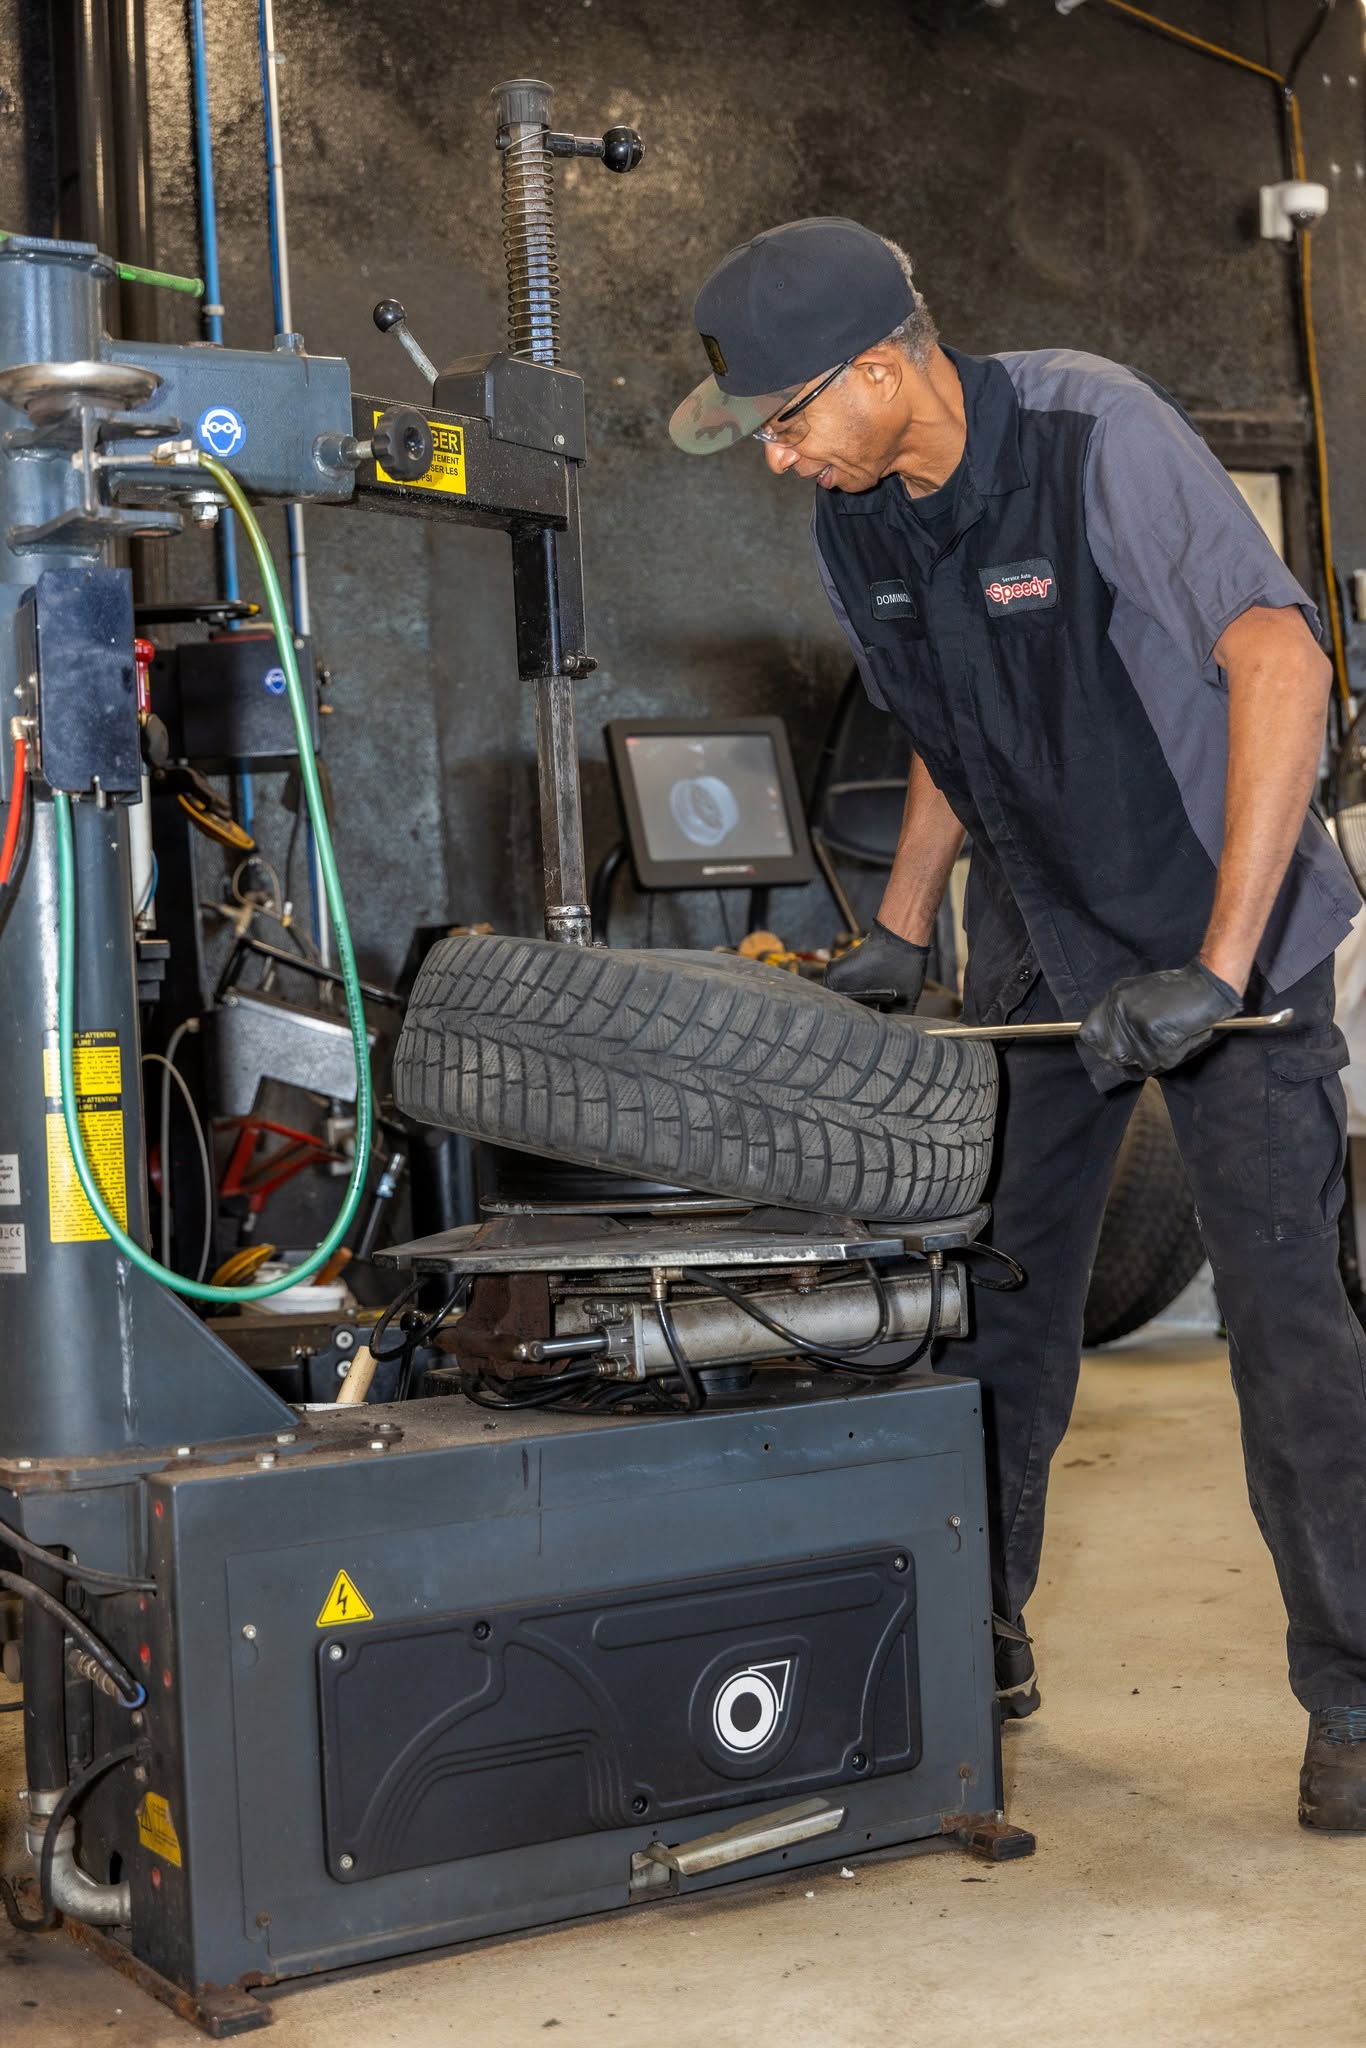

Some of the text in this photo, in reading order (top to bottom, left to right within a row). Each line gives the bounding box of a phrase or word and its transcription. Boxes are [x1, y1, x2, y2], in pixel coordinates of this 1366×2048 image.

[431, 430, 458, 451] GER
[432, 454, 459, 465] TEMENT
[430, 465, 459, 476] SER LES
[422, 473, 432, 482] PSI
[1001, 575, 1020, 583] Service
[986, 577, 1052, 604] Speedy
[85, 1031, 117, 1039] ATTENTION
